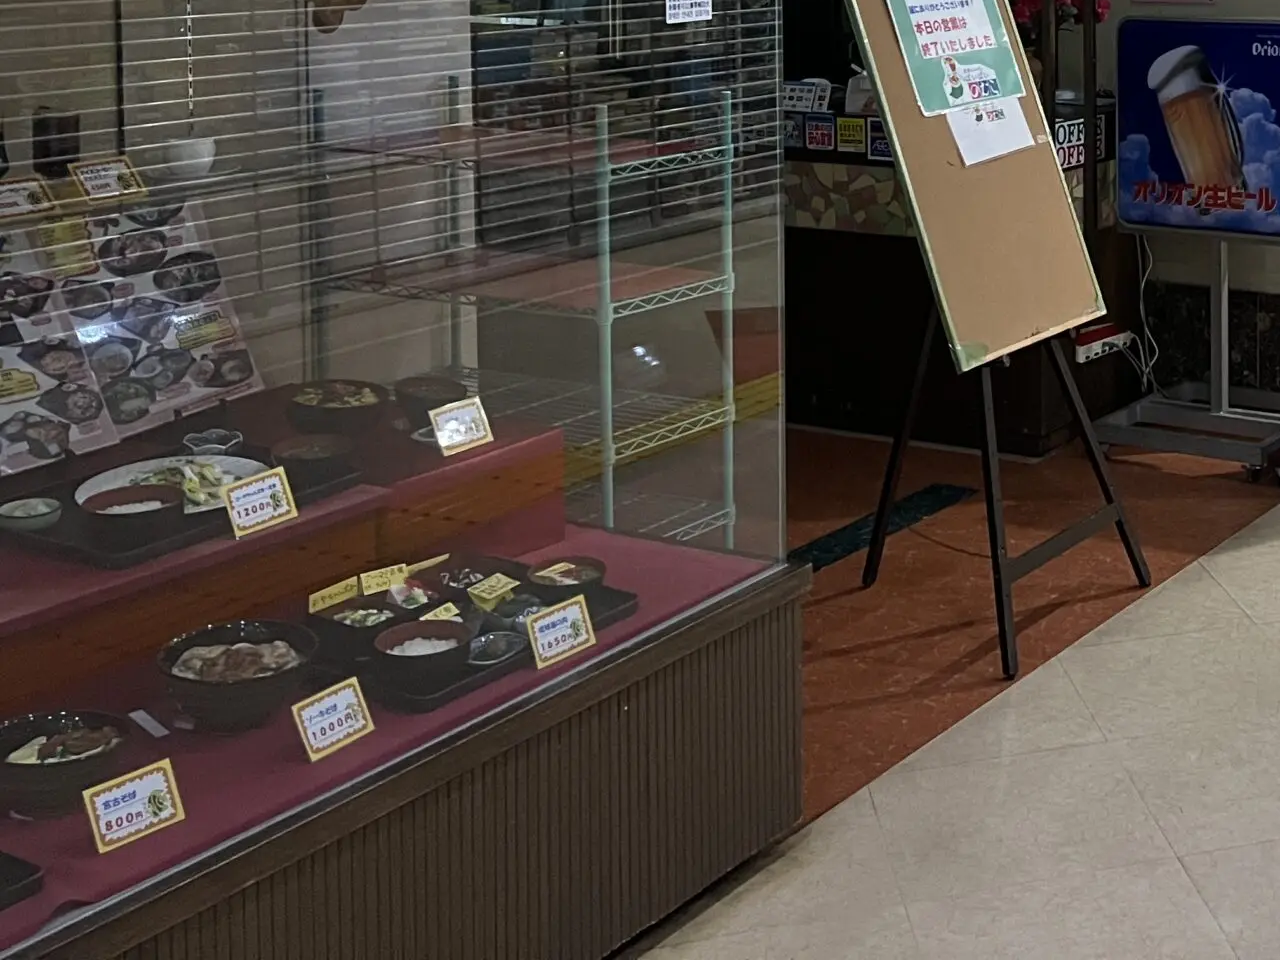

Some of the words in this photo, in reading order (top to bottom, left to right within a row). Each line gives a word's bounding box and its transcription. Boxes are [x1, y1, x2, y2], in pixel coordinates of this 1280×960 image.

[914, 17, 967, 35] 本日の営業は
[1132, 181, 1278, 213] オリオン生ビール
[104, 810, 144, 832] 800円
